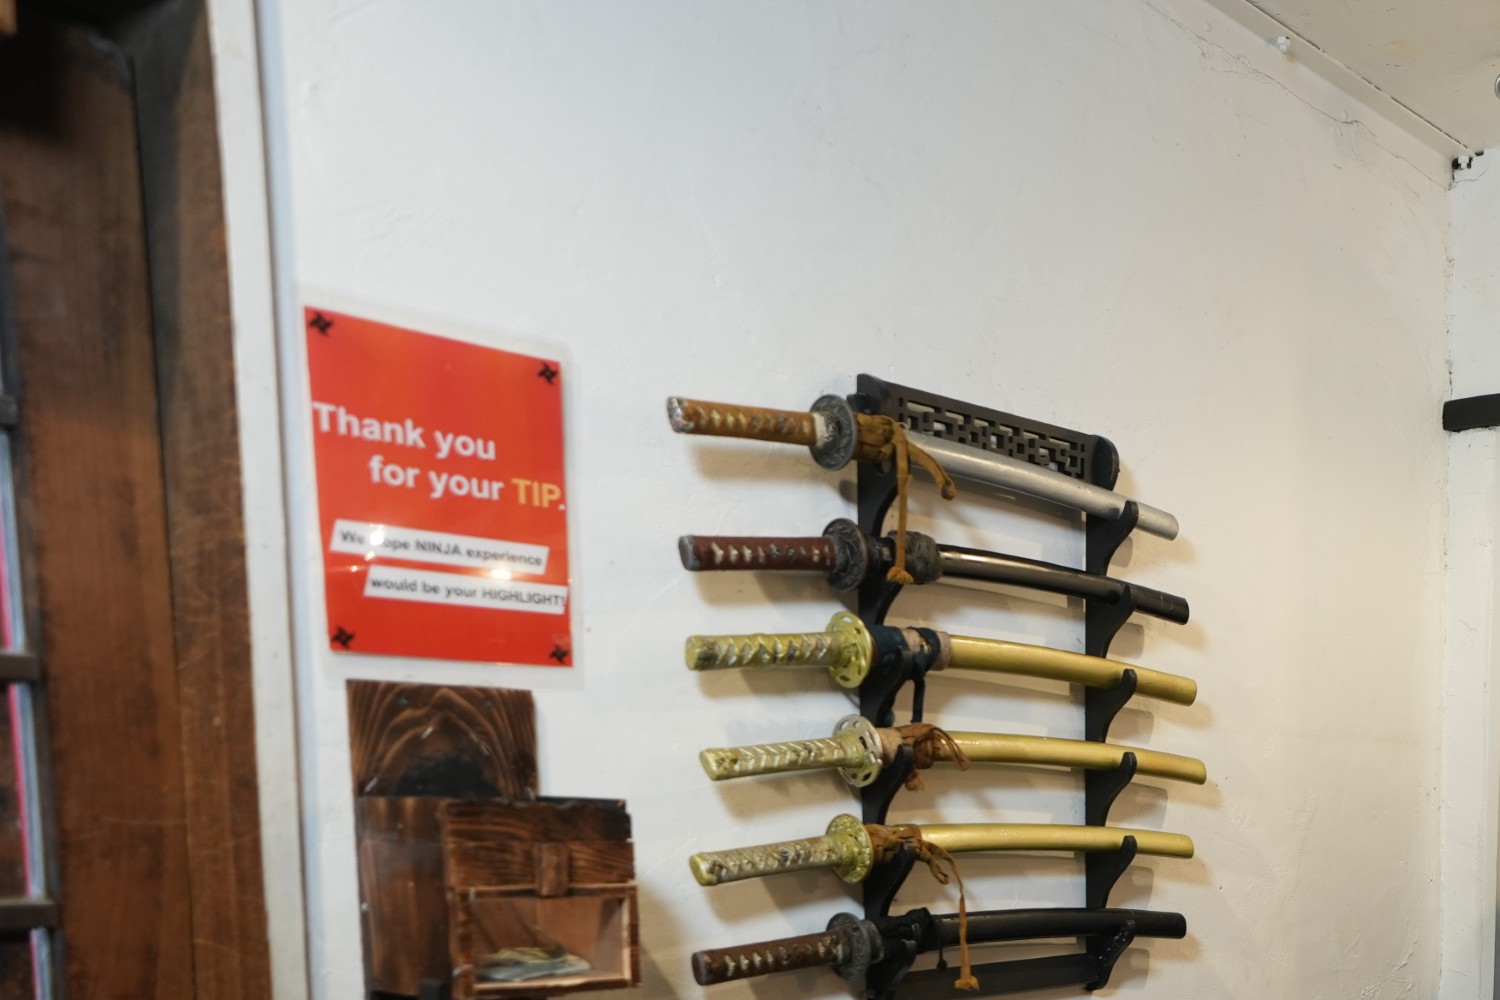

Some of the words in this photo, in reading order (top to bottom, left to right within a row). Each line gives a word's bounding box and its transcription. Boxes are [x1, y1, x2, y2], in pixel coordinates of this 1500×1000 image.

[313, 400, 426, 449] Thank
[434, 430, 496, 461] you
[369, 455, 420, 488] for
[428, 468, 504, 500] your
[511, 477, 566, 511] TIP.
[374, 530, 410, 551] ope
[416, 540, 463, 556] NINJA
[466, 547, 542, 567] experience
[371, 576, 417, 593] would
[423, 580, 440, 595] be
[445, 586, 477, 599] your
[482, 587, 567, 608] HIGHLIGHT!
